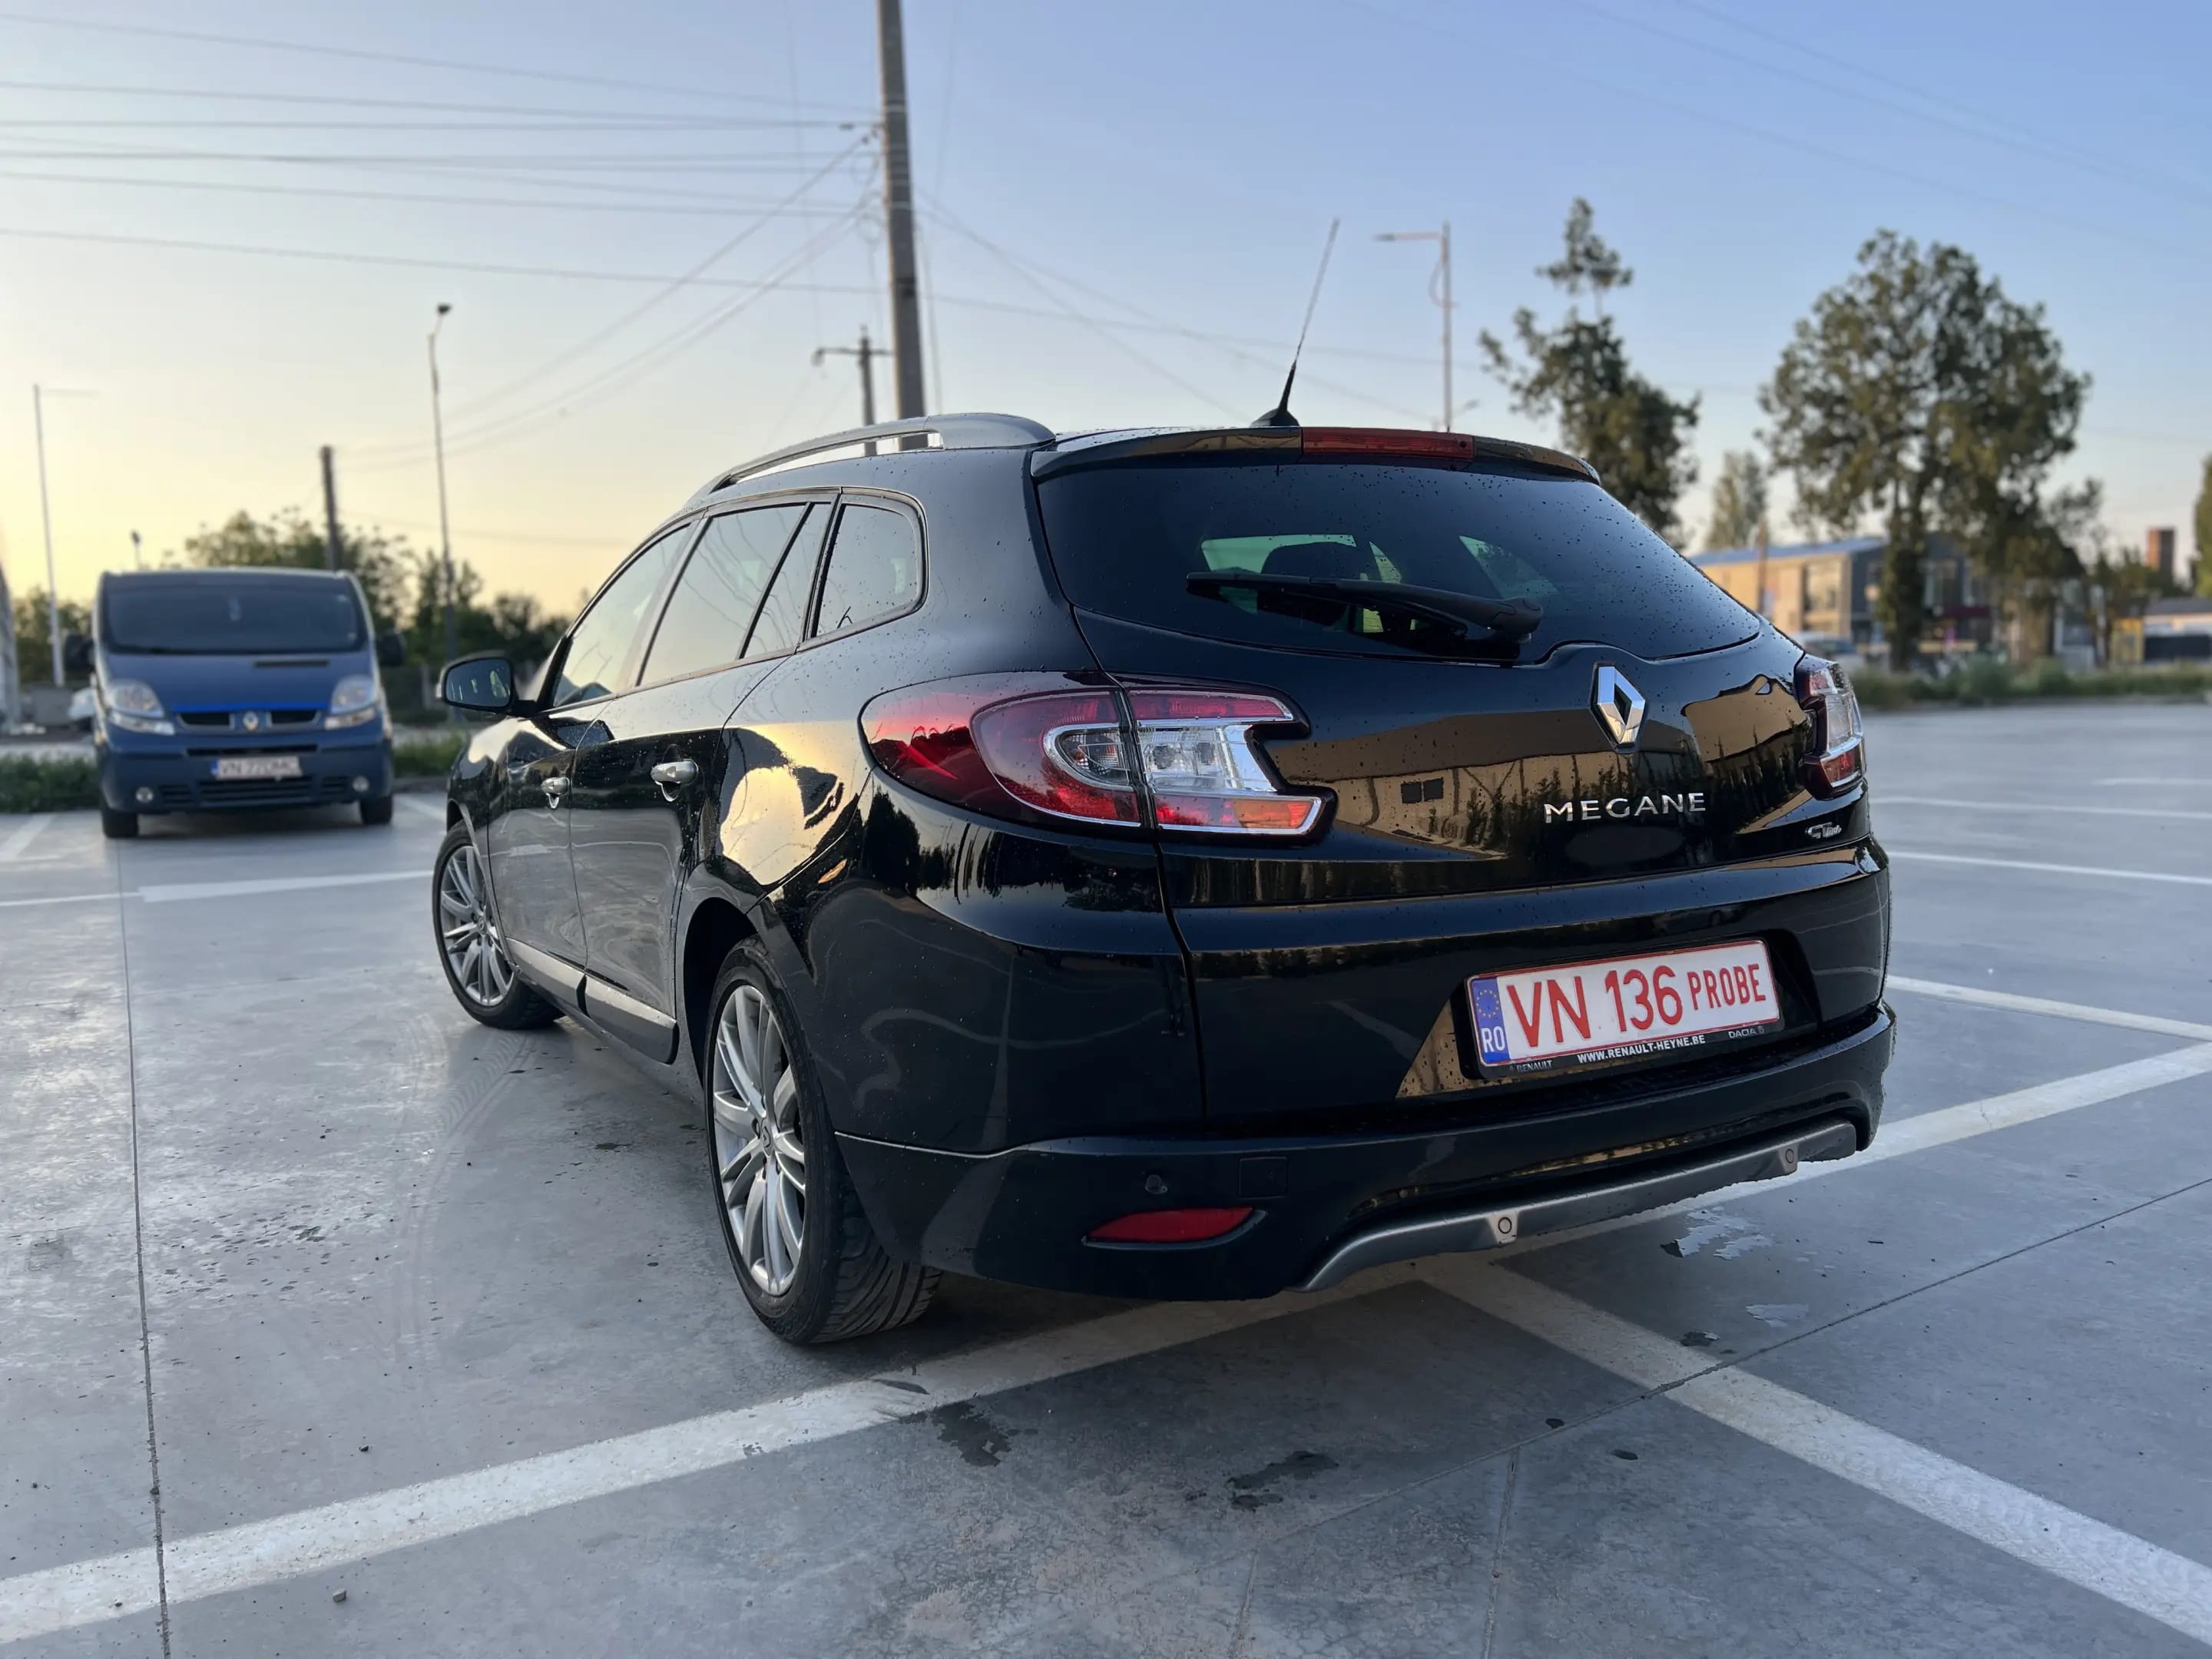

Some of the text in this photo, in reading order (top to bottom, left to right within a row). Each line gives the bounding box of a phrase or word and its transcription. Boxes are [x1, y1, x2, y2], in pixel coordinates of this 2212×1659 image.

[1544, 793, 1706, 823] MEGANE
[1507, 963, 1766, 1047] VN 136 PROBE
[1481, 1026, 1506, 1053] RO
[1728, 1028, 1757, 1039] DACIA
[1577, 1035, 1706, 1064] WWW.RENAULT-HEYNE.BE
[1517, 1060, 1553, 1073] RENAULT
